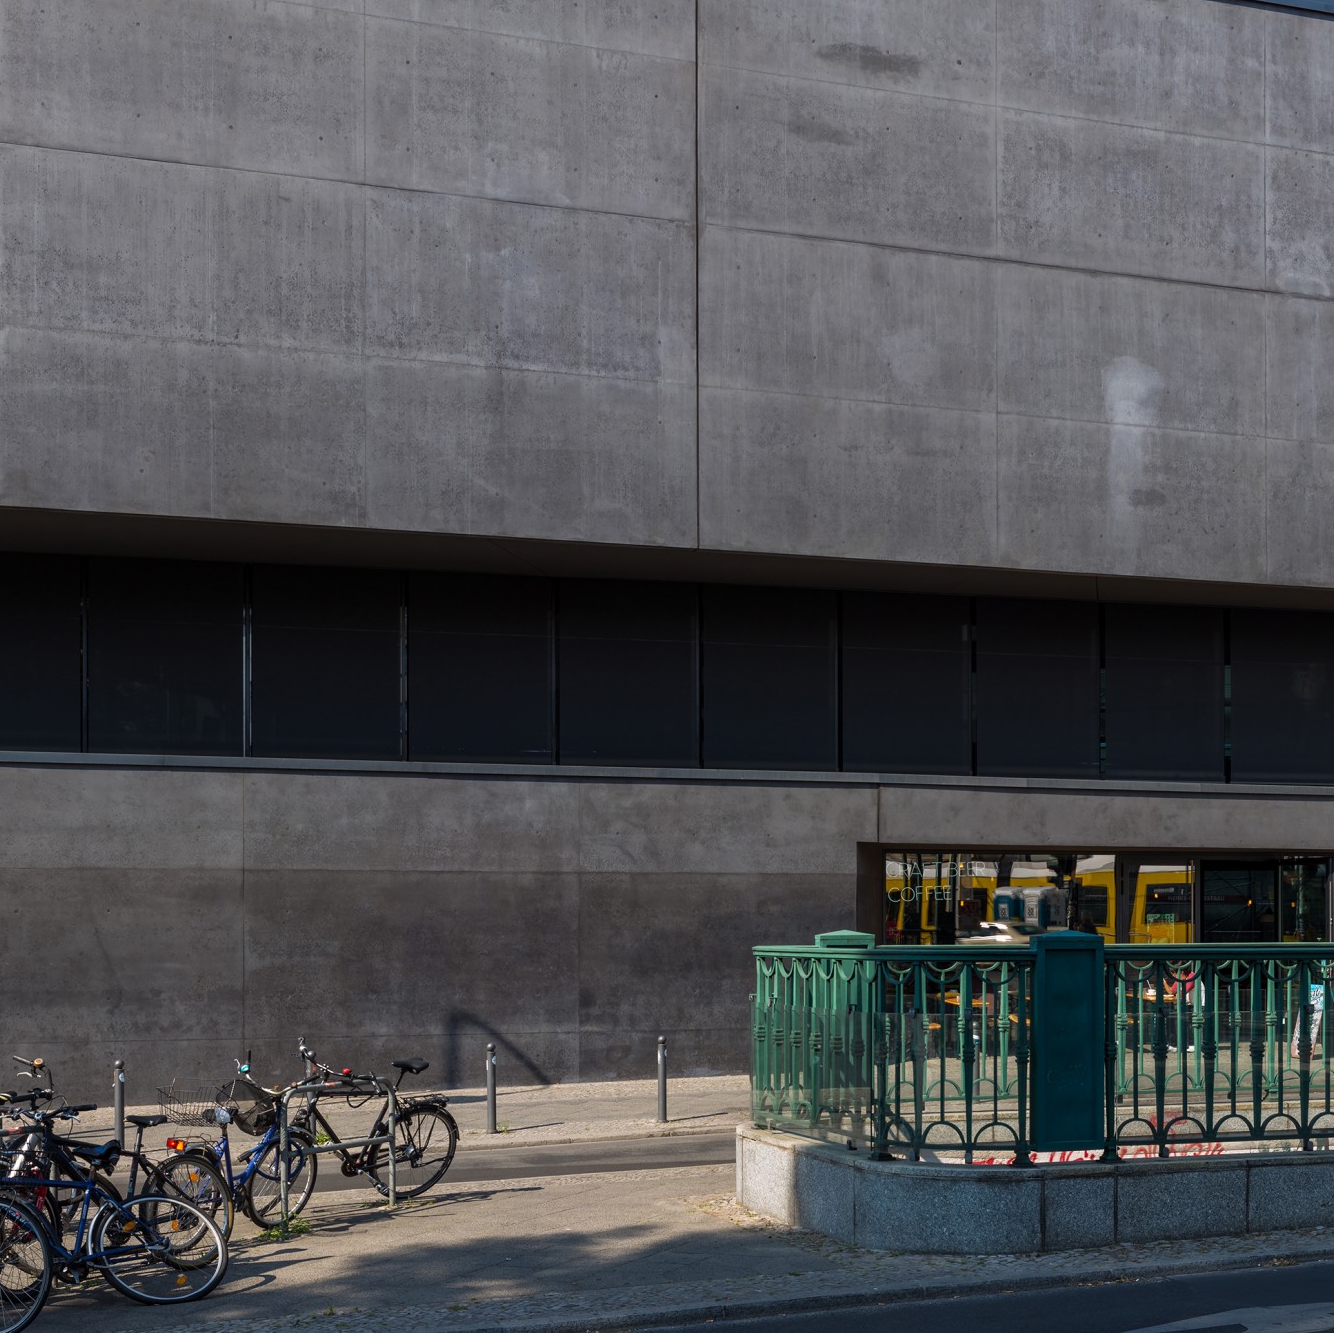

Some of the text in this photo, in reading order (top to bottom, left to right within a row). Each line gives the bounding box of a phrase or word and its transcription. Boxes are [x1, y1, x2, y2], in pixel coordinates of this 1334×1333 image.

[885, 861, 986, 878] CRAFT BEER
[887, 884, 953, 903] COFFEE
